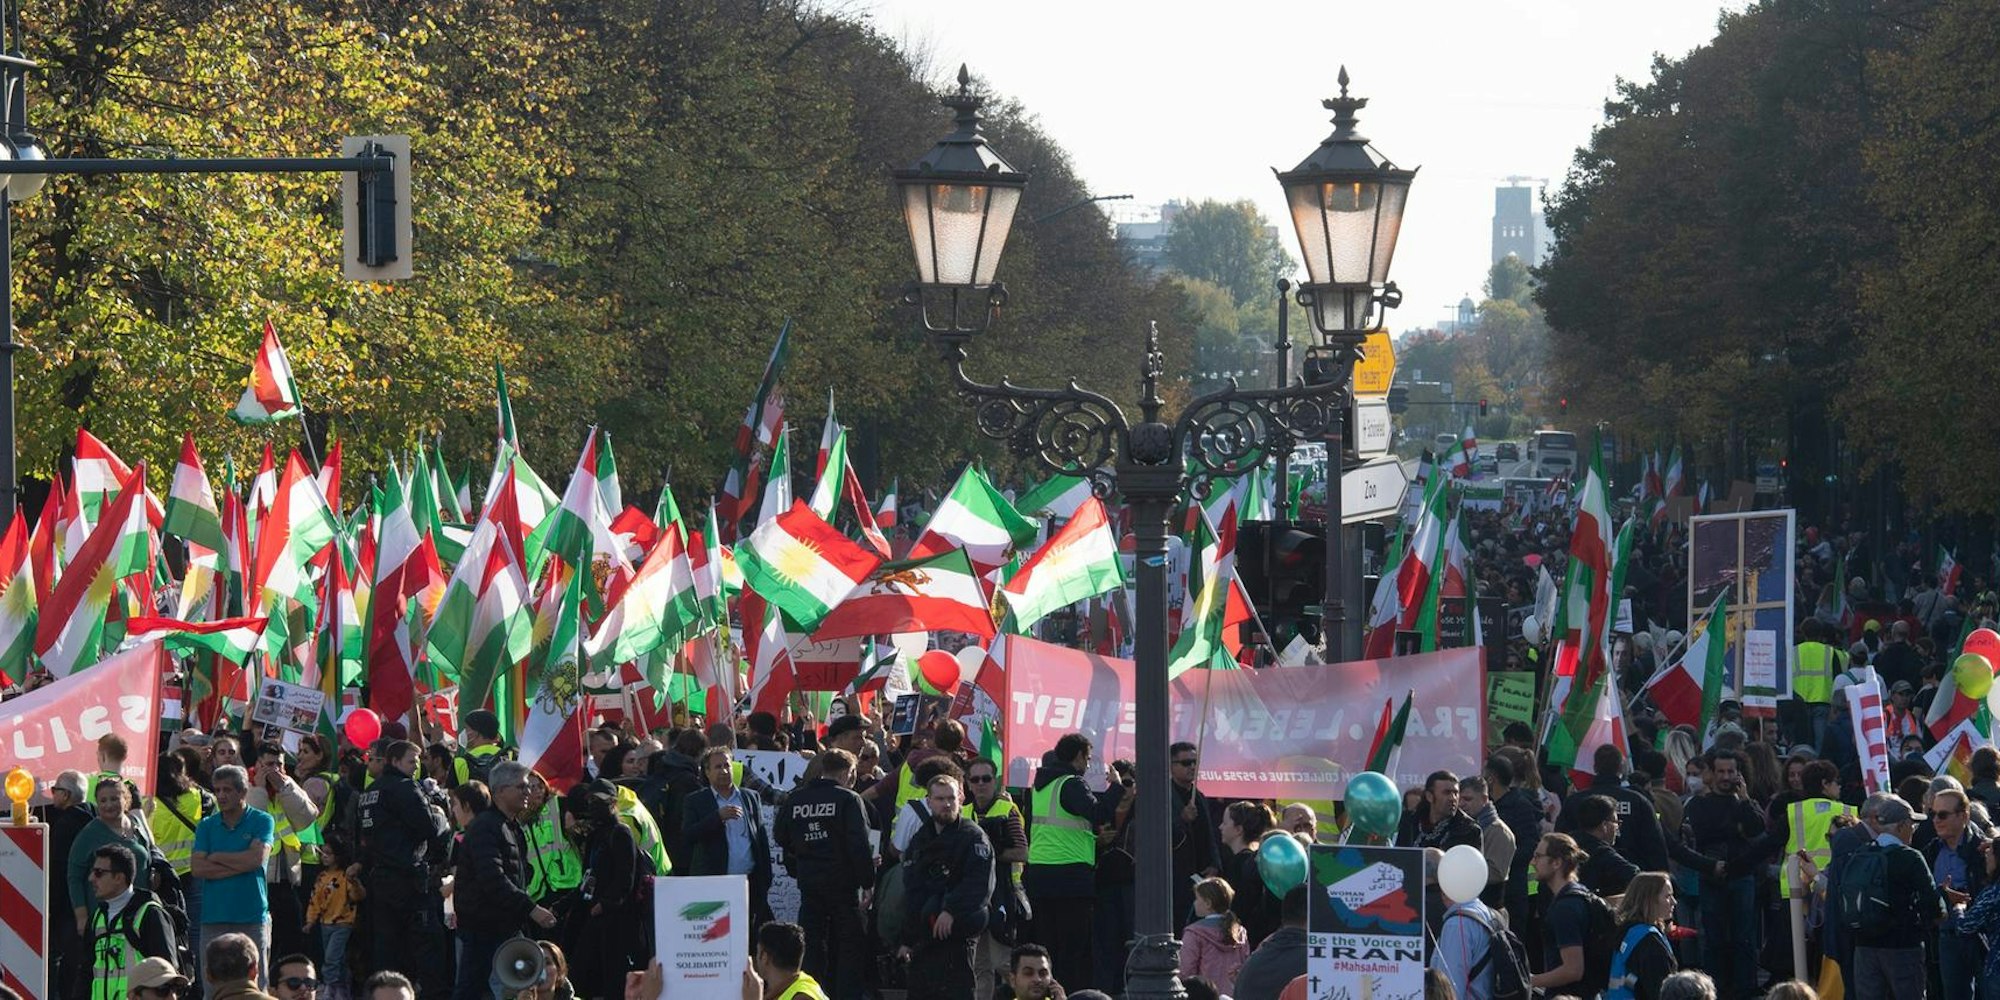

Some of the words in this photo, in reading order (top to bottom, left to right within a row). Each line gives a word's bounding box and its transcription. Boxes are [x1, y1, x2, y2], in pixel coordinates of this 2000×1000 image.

[1364, 481, 1377, 499] Zoo
[792, 803, 836, 819] POLIZEI
[808, 822, 821, 831] BE
[1309, 935, 1327, 945] Be
[1332, 936, 1356, 946] the
[1361, 937, 1402, 948] Voice
[1406, 940, 1421, 949] of
[1309, 946, 1422, 962] IRAN
[675, 961, 729, 969] SOLIDARITY
[1334, 962, 1399, 973] #MahsaAmini
